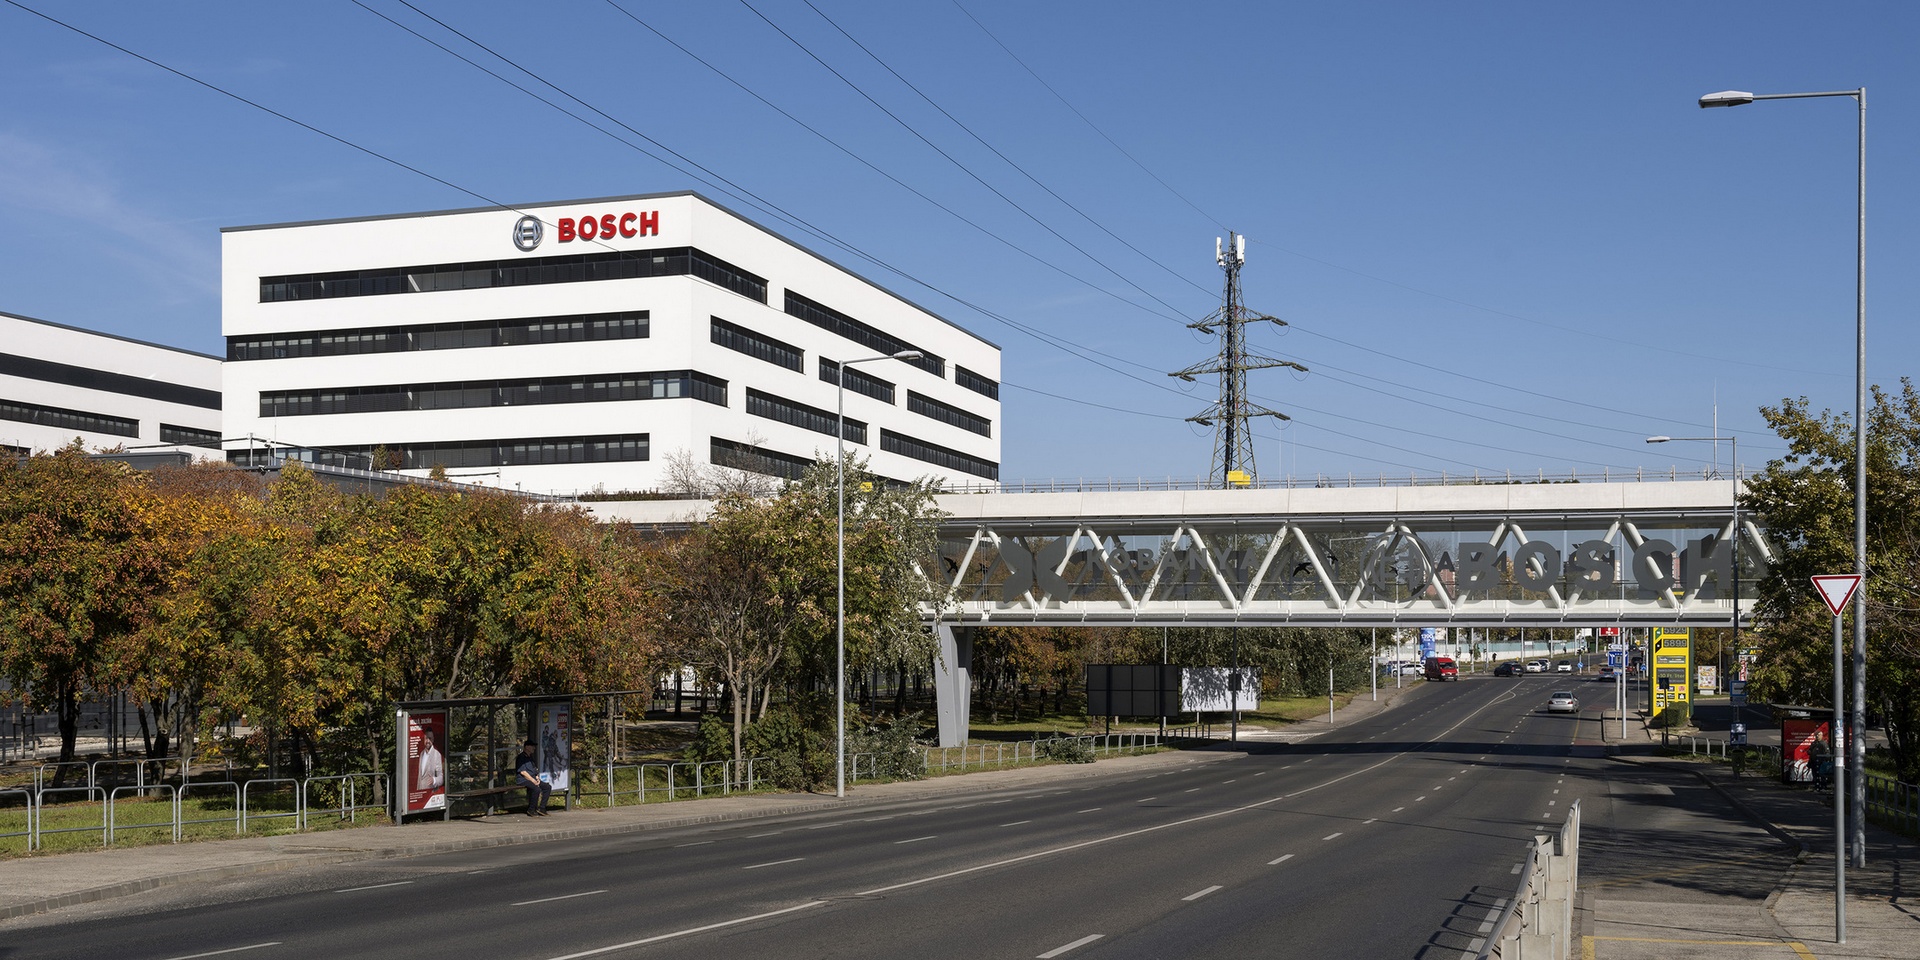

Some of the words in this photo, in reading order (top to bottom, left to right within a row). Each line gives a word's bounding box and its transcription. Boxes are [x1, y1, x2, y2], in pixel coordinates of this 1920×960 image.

[558, 210, 658, 243] BOSCH
[1086, 541, 1262, 570] KŐBÁNYA
[1459, 539, 1731, 591] BOSCH
